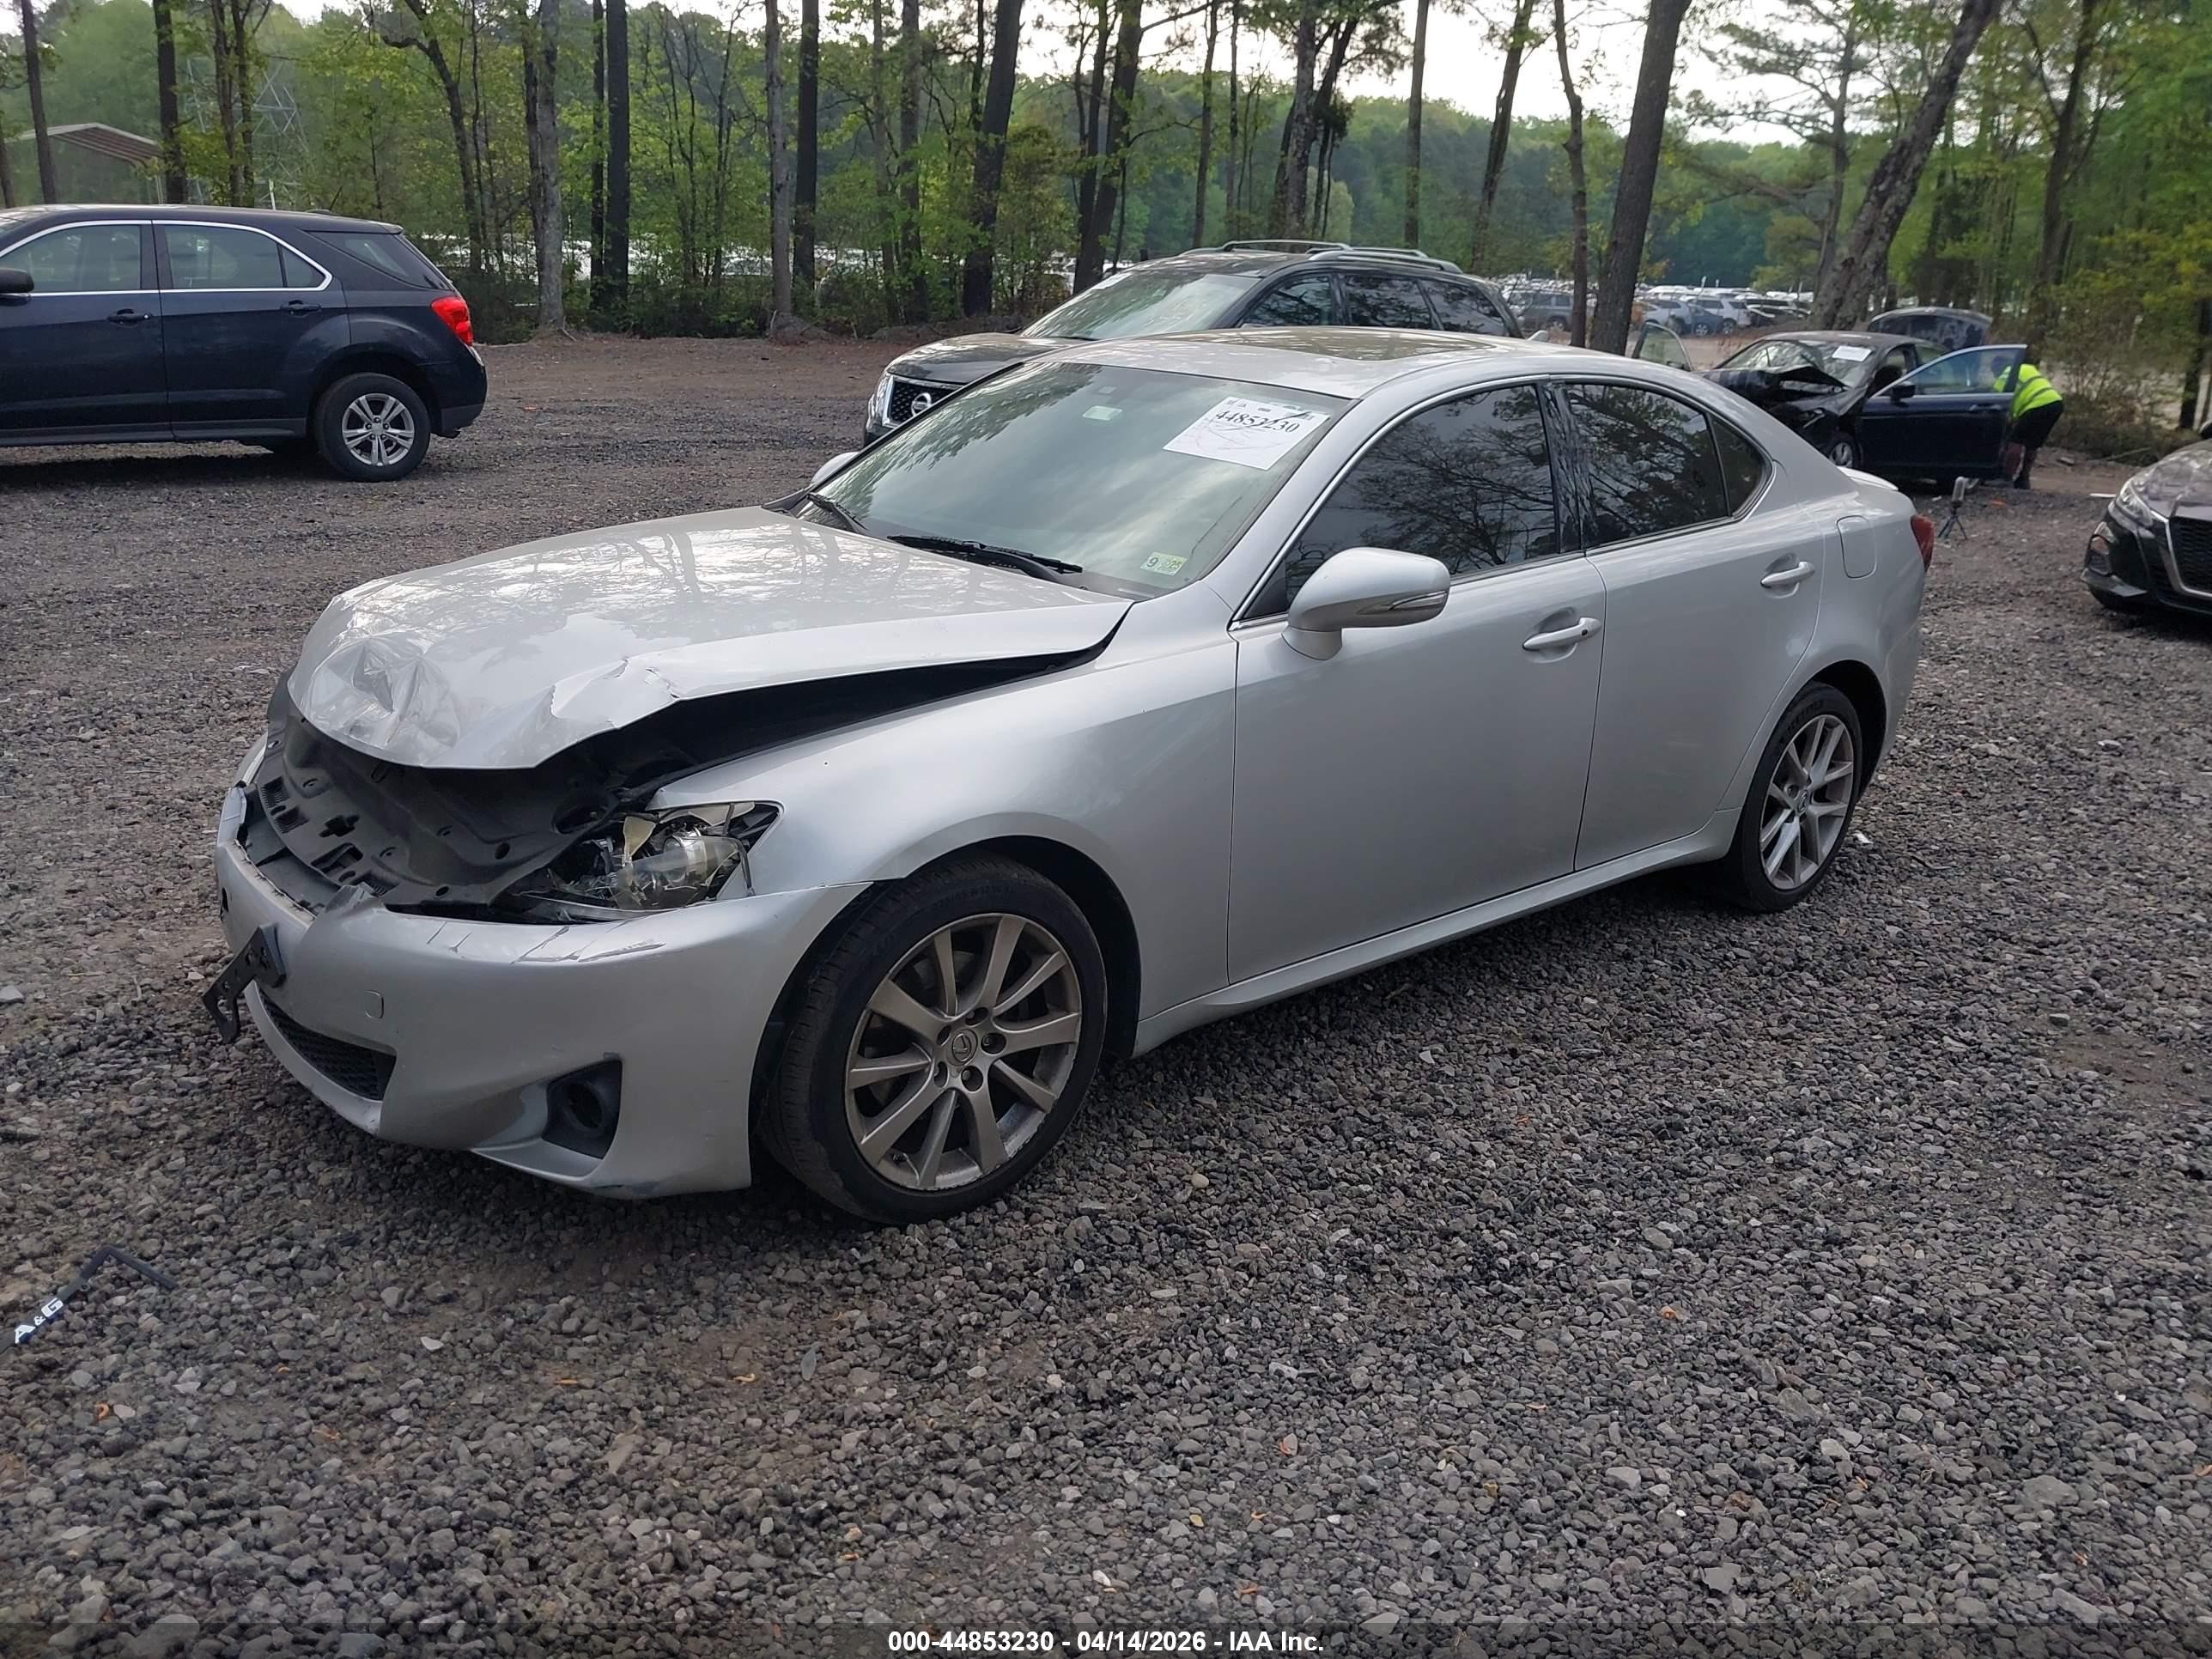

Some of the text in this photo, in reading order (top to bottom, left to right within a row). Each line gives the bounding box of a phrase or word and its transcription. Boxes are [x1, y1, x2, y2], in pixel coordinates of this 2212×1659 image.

[1215, 410, 1301, 434] 44853230
[1146, 556, 1159, 568] 9
[15, 1297, 64, 1345] A&G
